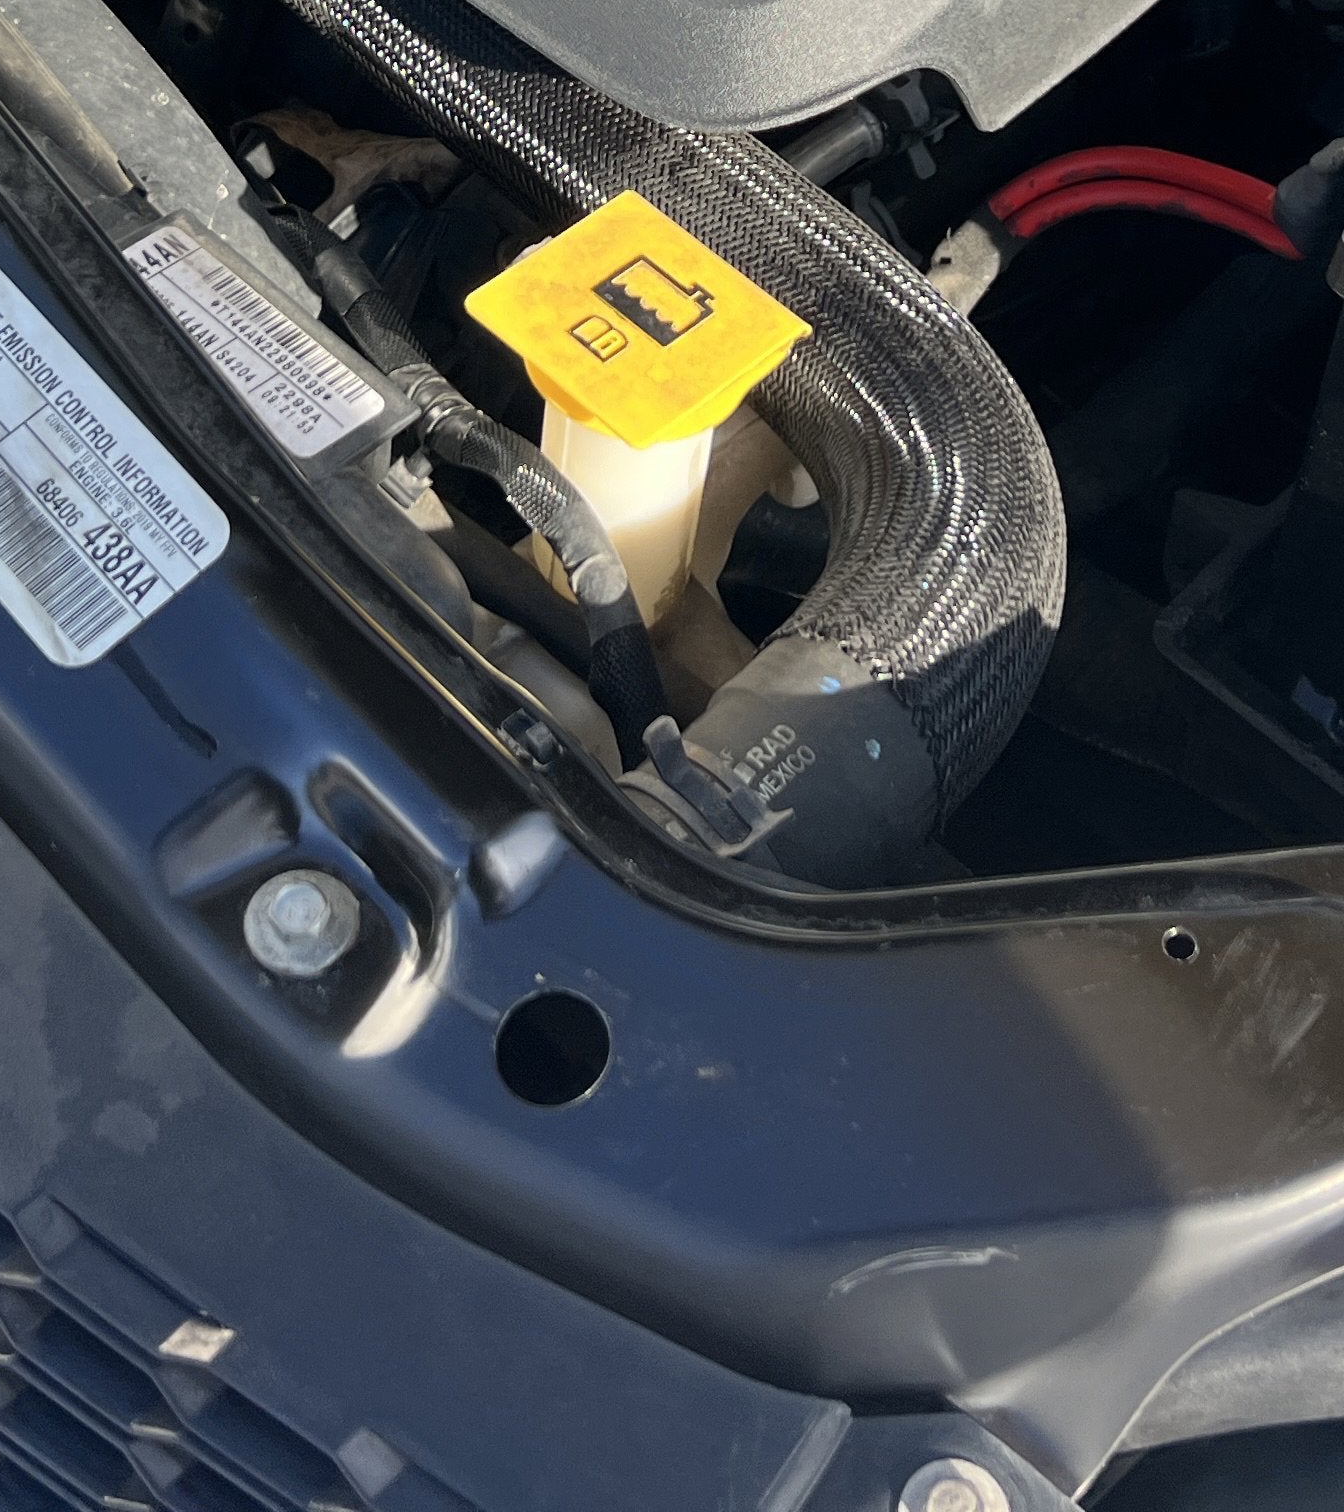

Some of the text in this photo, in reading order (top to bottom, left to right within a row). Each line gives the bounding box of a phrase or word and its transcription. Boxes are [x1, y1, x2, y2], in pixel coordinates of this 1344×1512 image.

[214, 348, 256, 383] S4204
[44, 412, 84, 454] CONFORMS
[79, 450, 93, 464] TO
[87, 460, 137, 513] REGULATIONS:
[148, 527, 164, 544] MY
[158, 539, 177, 559] FFV
[53, 388, 121, 458] CONTROL
[111, 452, 210, 557] INFORMATION
[67, 459, 137, 534] ENGINE: 3.6L
[34, 476, 163, 605] 68406 438AA
[746, 724, 796, 768] RAD
[758, 745, 816, 804] MEXICO
